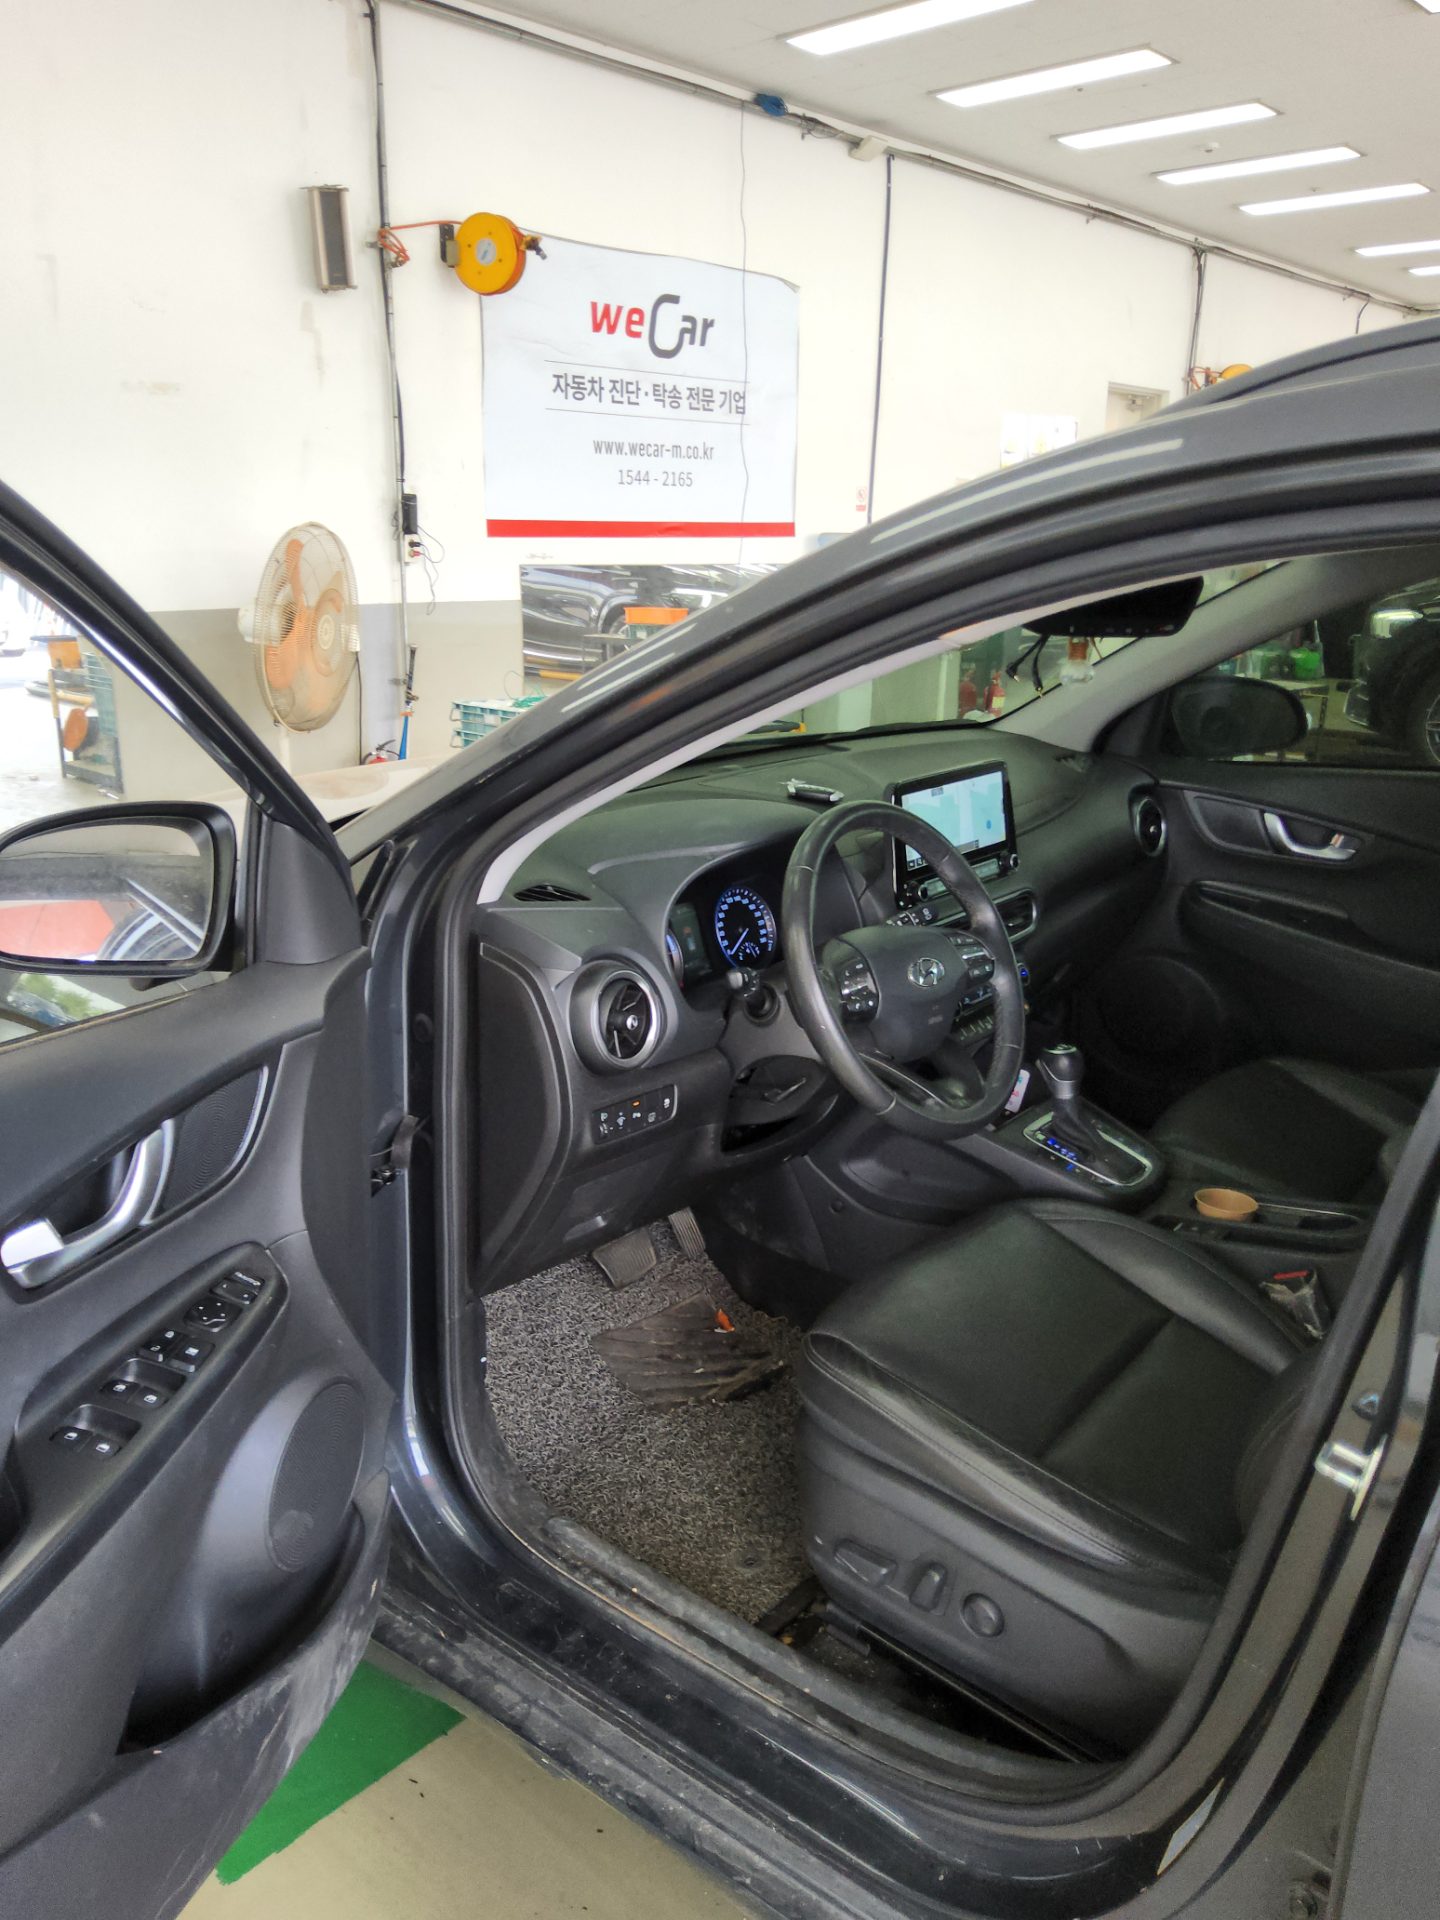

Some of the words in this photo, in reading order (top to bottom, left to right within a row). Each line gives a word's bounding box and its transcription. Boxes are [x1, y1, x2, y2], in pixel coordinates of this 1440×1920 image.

[552, 372, 605, 403] 자동차
[686, 386, 715, 412] 전문
[719, 389, 746, 415] 기업
[593, 440, 714, 460] www.wecar-m.co.kr
